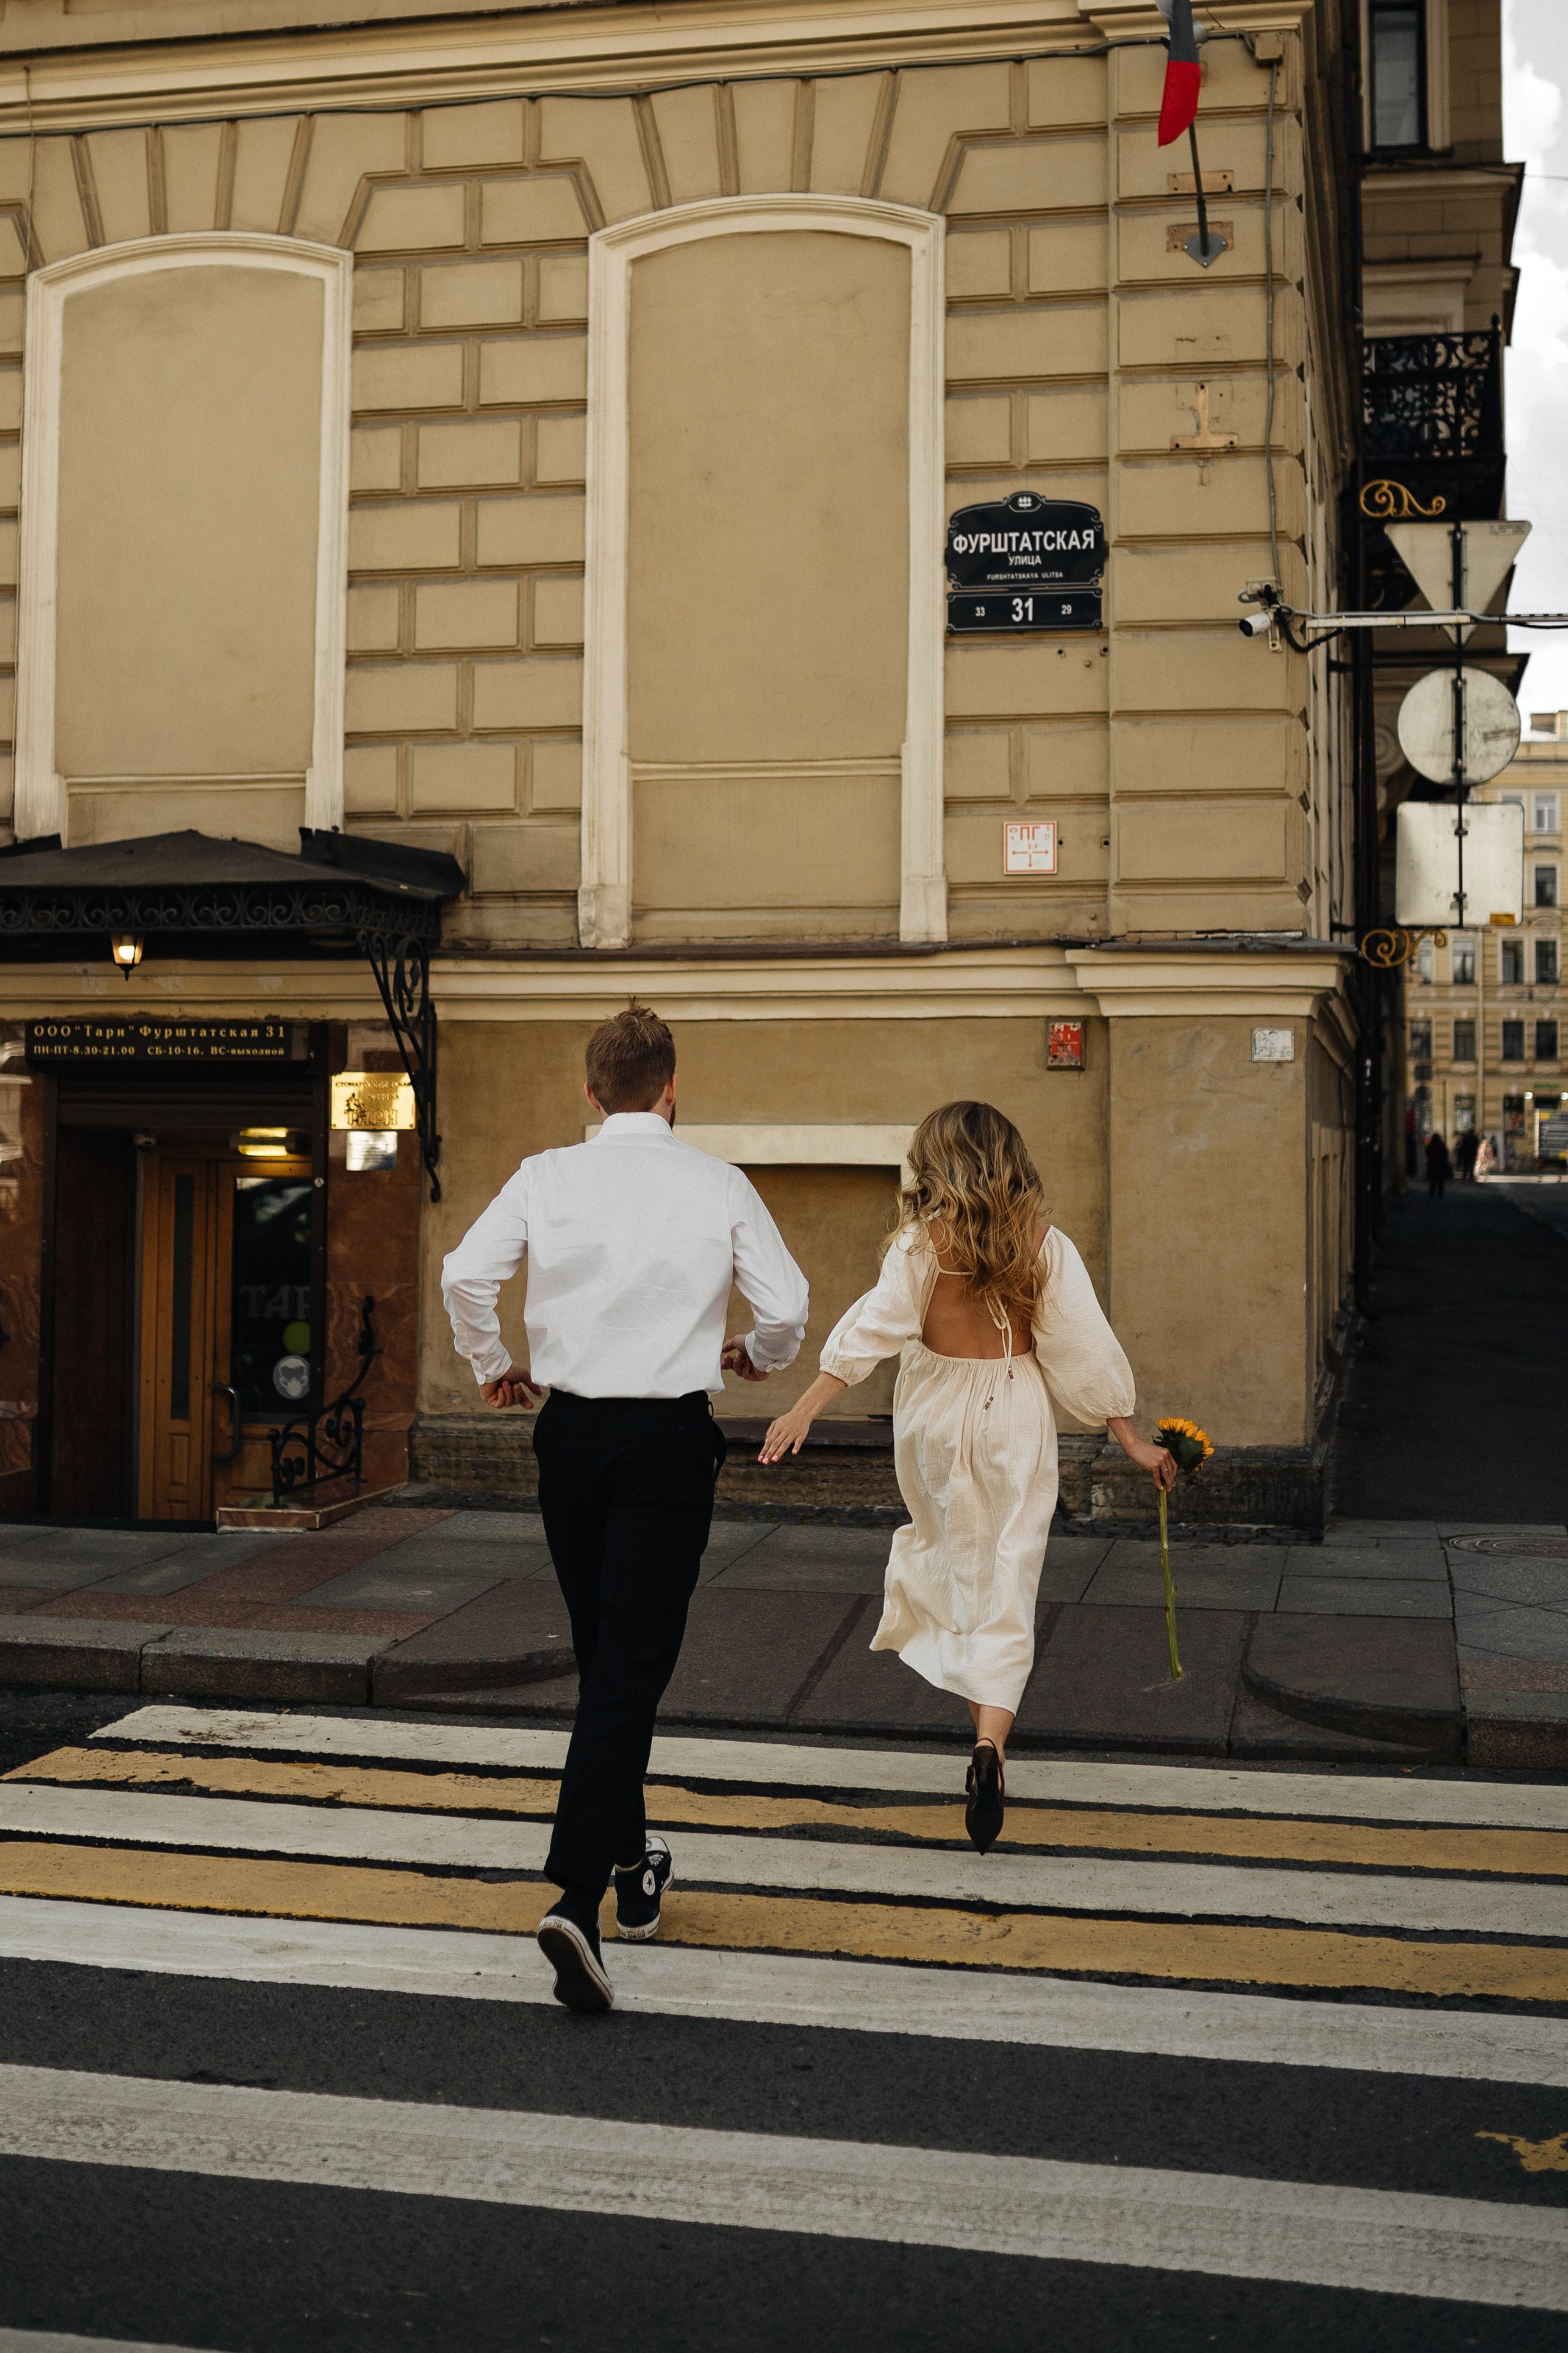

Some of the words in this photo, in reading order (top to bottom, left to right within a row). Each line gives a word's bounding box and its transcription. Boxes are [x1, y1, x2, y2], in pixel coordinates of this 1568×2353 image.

[953, 529, 1095, 554] ФУРШТАТСКАЯ
[1008, 555, 1042, 566] УЛИЦА
[987, 573, 1039, 581] FURSHTATSKAYA
[975, 607, 986, 617] 33
[1012, 597, 1034, 622] 31
[1061, 604, 1072, 615] 29
[34, 1024, 71, 1037] ООО
[139, 1025, 259, 1039] Фурштатская
[265, 1026, 284, 1038] 31
